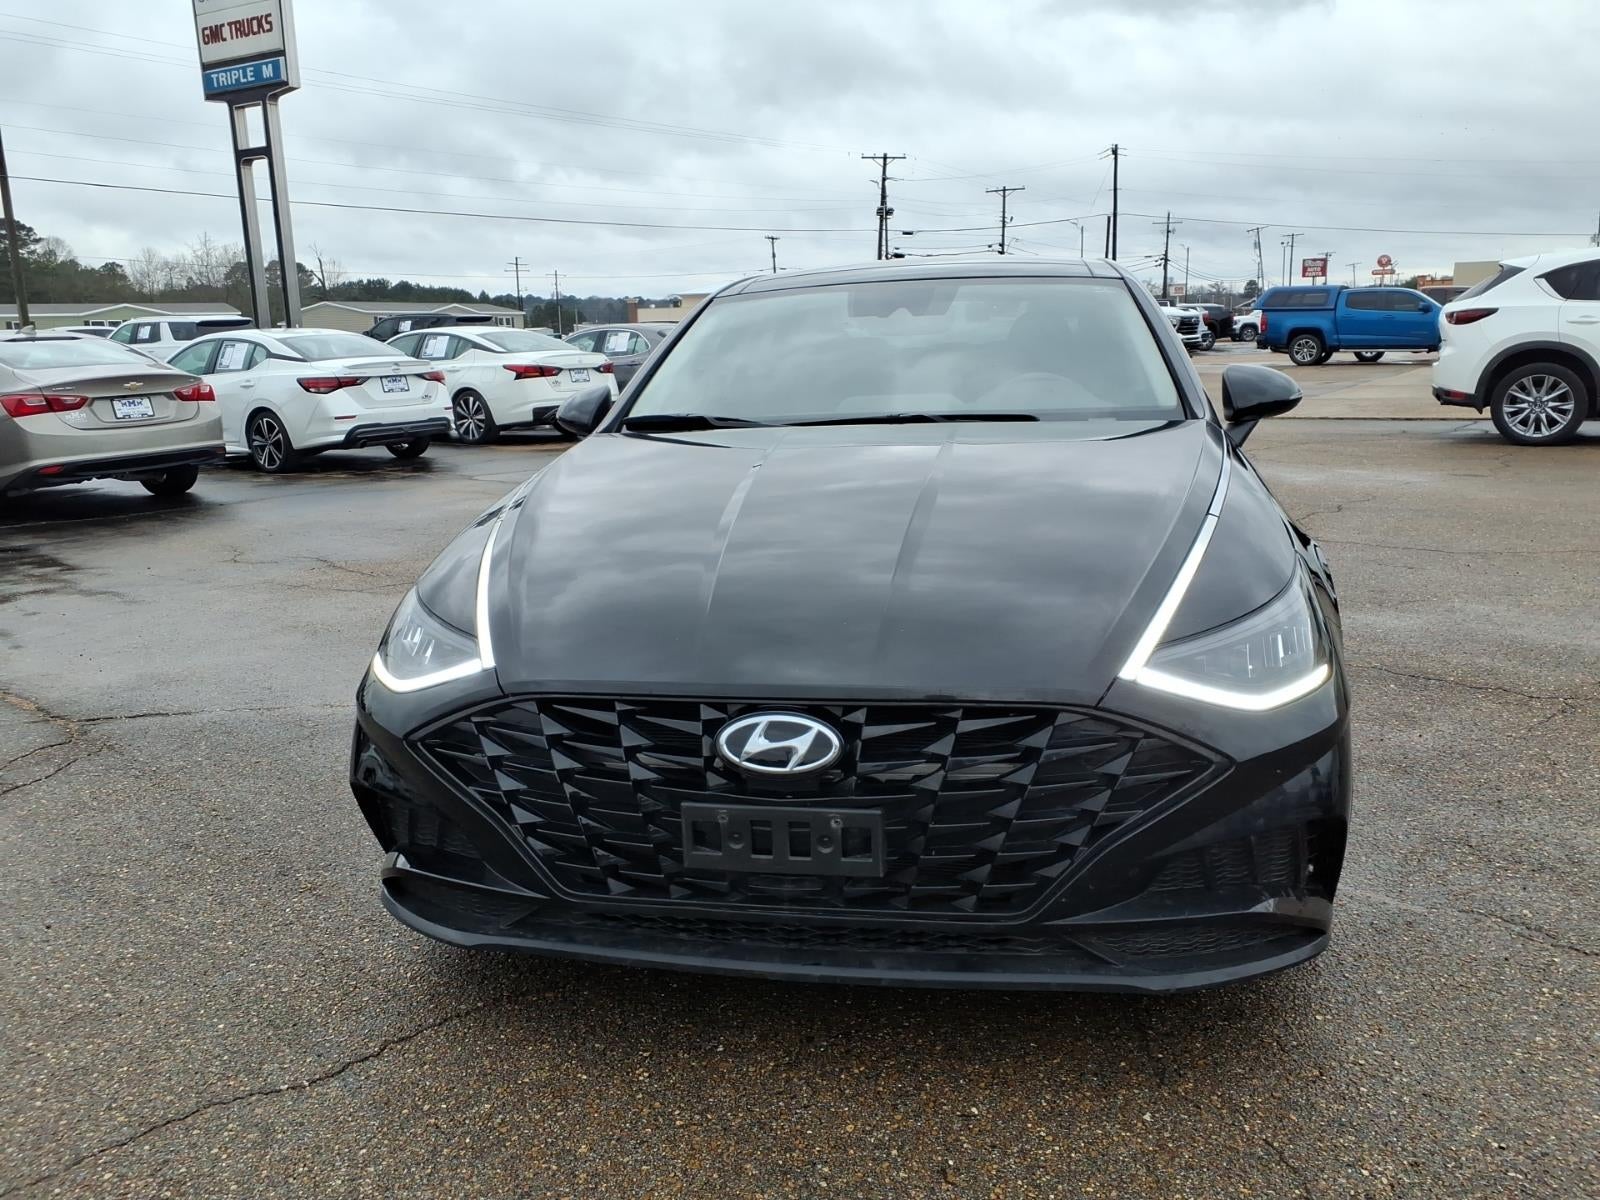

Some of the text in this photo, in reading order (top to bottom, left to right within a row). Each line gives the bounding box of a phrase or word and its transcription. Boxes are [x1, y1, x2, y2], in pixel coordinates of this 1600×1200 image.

[201, 13, 273, 45] GMC TRUCKS
[211, 63, 273, 88] TRIPLE M
